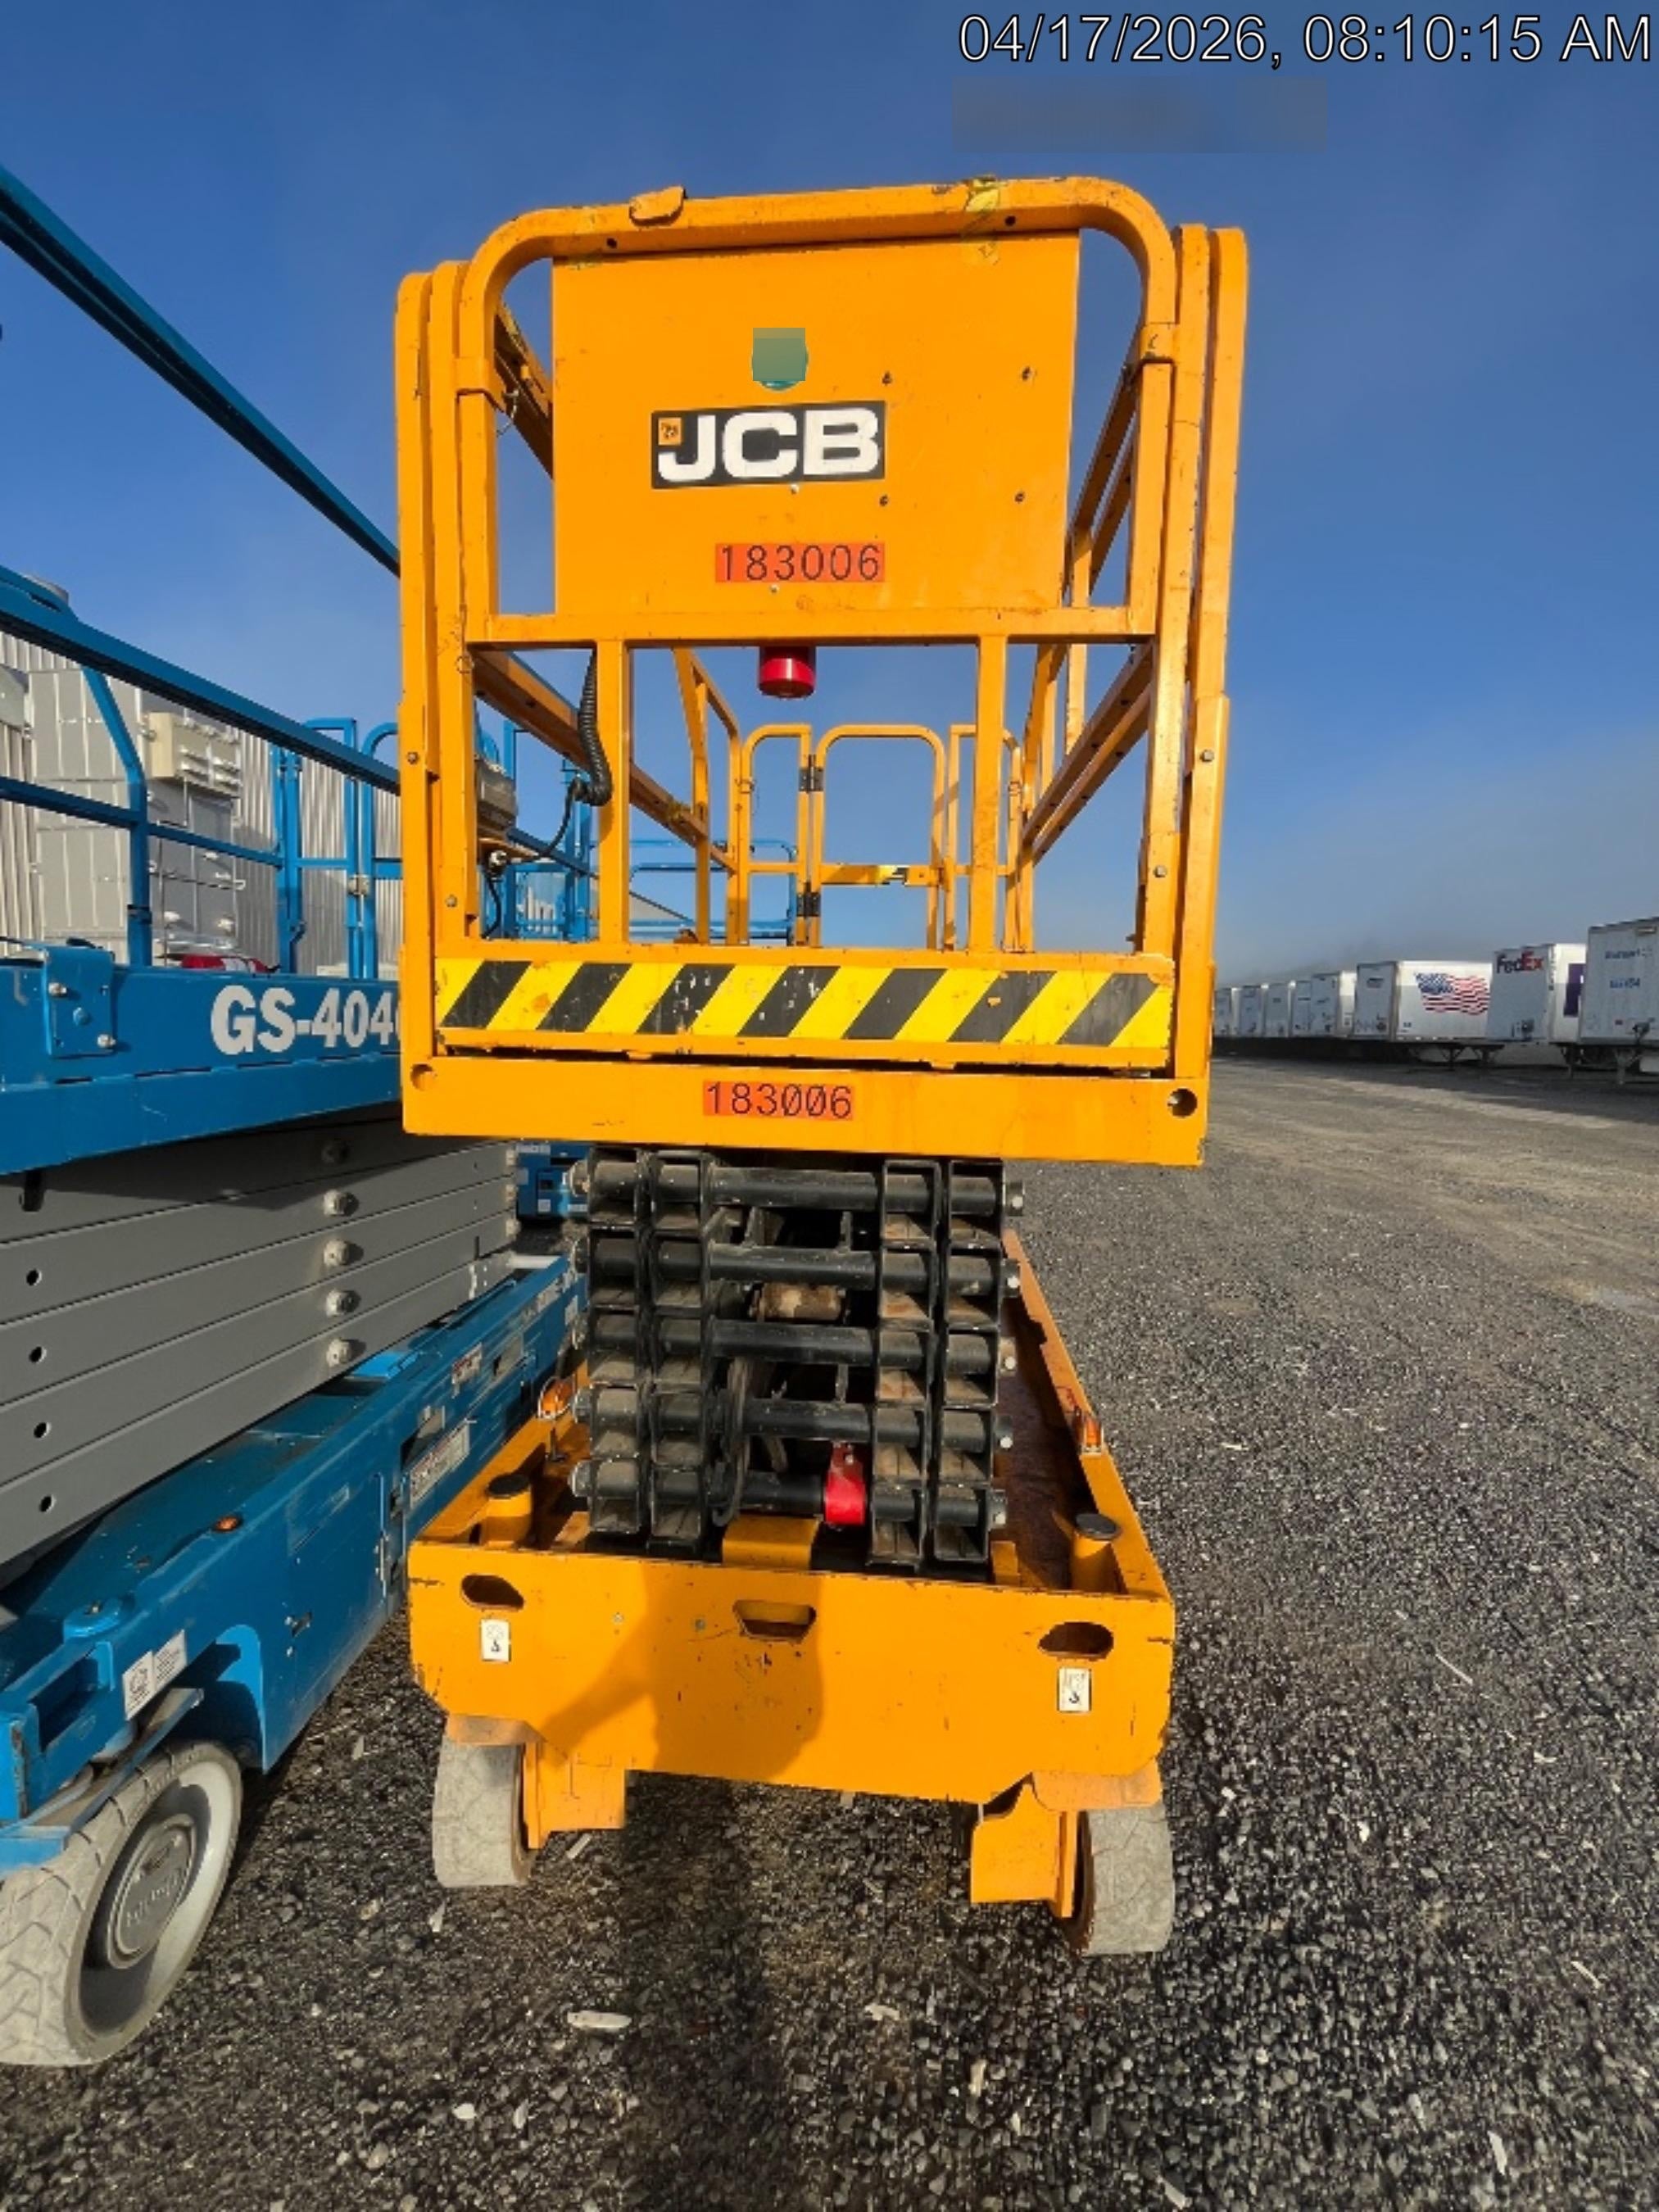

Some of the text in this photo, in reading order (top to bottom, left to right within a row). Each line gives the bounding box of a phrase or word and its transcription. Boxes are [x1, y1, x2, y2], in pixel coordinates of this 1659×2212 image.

[657, 407, 880, 482] JCB
[721, 544, 880, 581] 183006
[1496, 950, 1543, 974] FedEx
[211, 984, 401, 1055] GS-404
[707, 1081, 852, 1119] 183006
